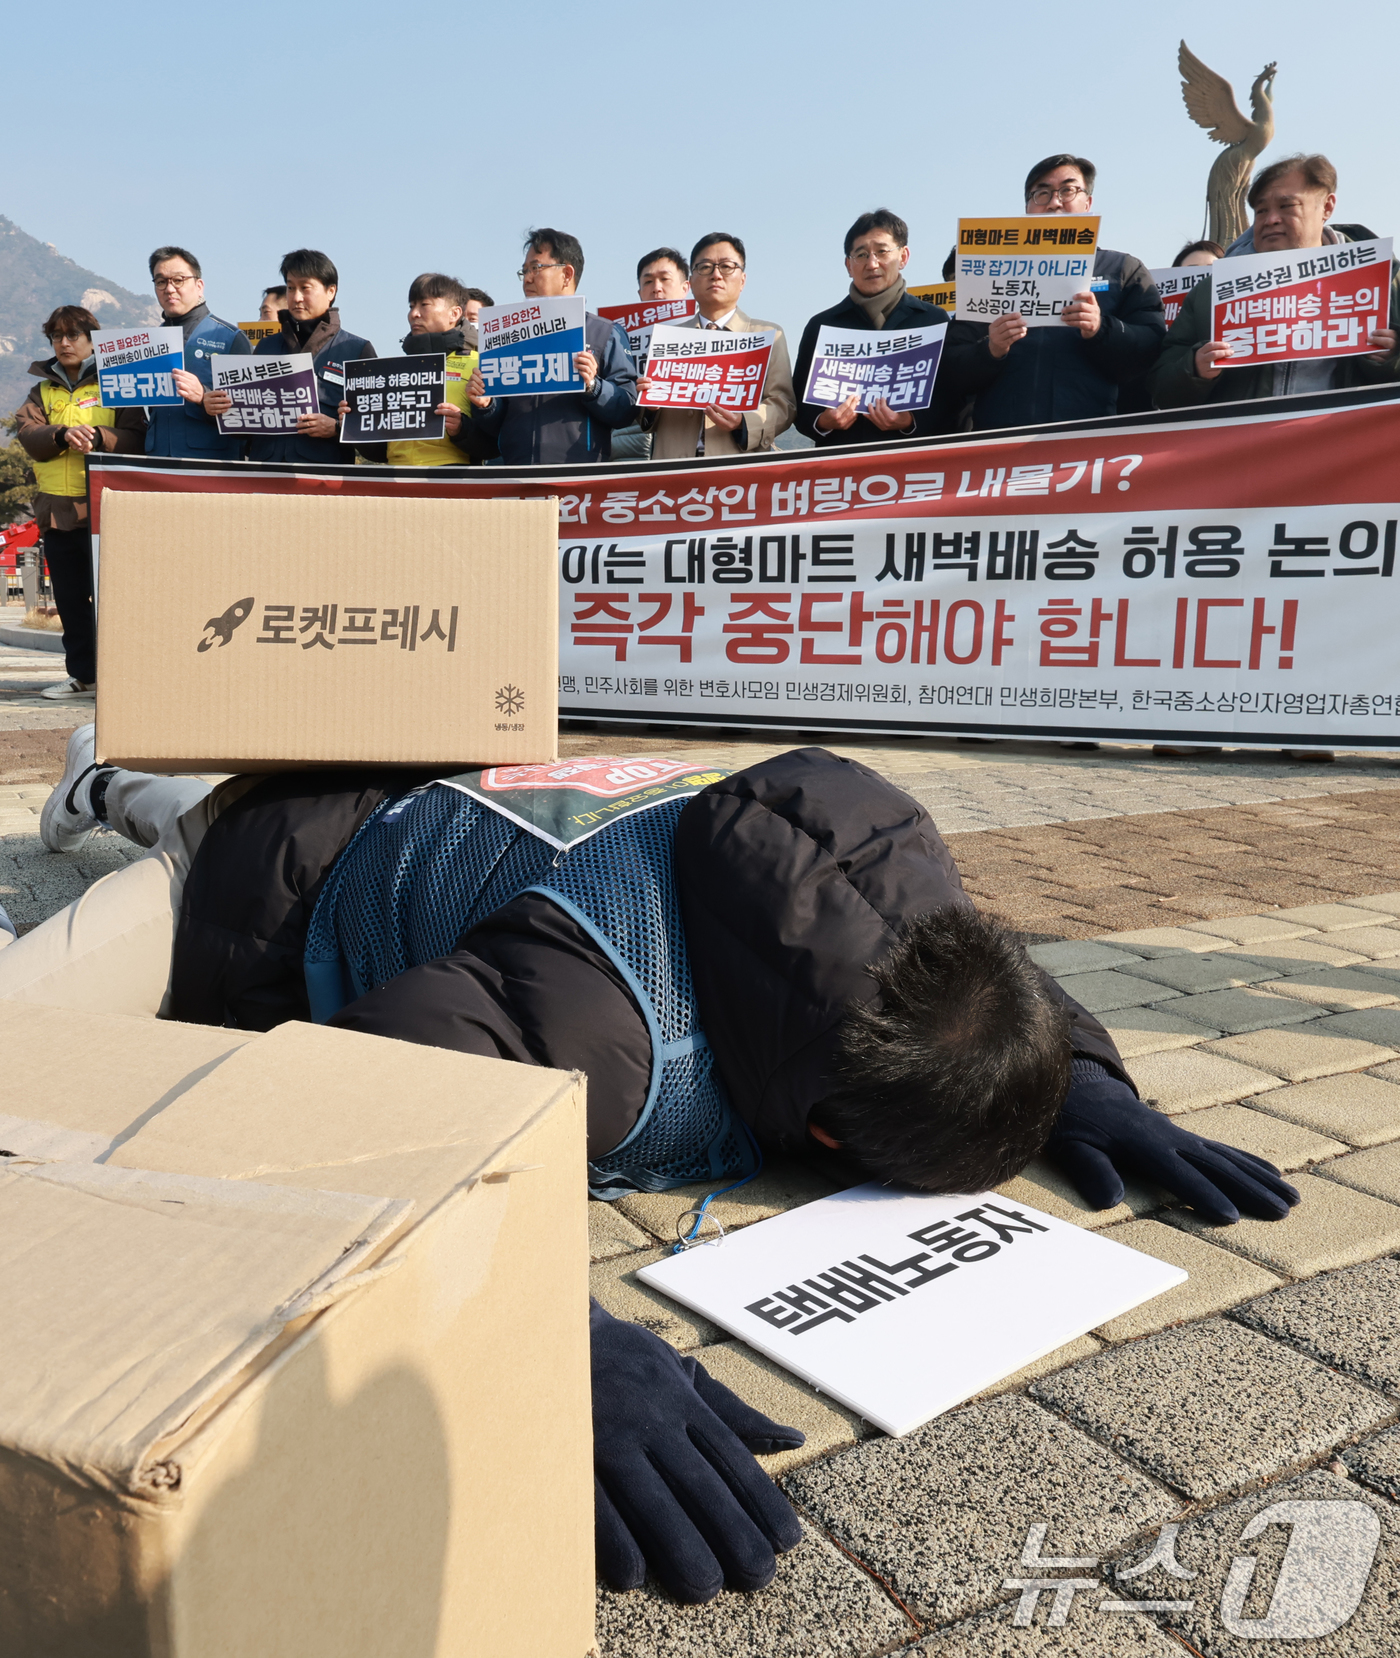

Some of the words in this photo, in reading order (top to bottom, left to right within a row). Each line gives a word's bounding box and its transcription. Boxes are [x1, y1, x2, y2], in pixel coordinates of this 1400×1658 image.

[960, 229, 1019, 246] 대형마트
[1023, 228, 1095, 245] 새벽배송
[961, 259, 986, 276] 쿠팡
[989, 260, 1034, 277] 잡기가
[1038, 259, 1088, 277] 아니라
[1216, 266, 1293, 301] 골목상권
[1298, 246, 1377, 279] 파괴하는
[991, 280, 1040, 299] 노동자,
[642, 300, 687, 324] 유발법
[966, 300, 1014, 316] 소상공인
[1222, 293, 1322, 325] 새벽배송
[1328, 286, 1380, 315] 논의
[483, 319, 499, 335] 지금
[502, 305, 541, 328] 필요한건
[98, 340, 115, 354] 지금
[117, 333, 150, 349] 필요한건
[484, 326, 530, 350] 새벽배송이
[533, 317, 567, 336] 아니라
[824, 343, 872, 357] 과로사
[876, 335, 923, 355] 부르는
[1222, 316, 1377, 358] 중단하라!
[102, 350, 142, 368] 새벽배송이
[145, 343, 169, 358] 아니라
[652, 342, 706, 357] 골목상권
[711, 336, 765, 353] 파괴하는
[217, 369, 252, 386] 과로사
[255, 361, 293, 379] 부르는
[346, 375, 386, 392] 새벽배송
[388, 371, 444, 387] 허용이라니
[652, 360, 723, 381] 새벽배송
[726, 364, 763, 382] 논의
[818, 359, 892, 383] 새벽배송
[896, 358, 933, 381] 논의
[280, 387, 312, 405] 논의
[356, 393, 383, 412] 명절
[386, 390, 431, 410] 앞두고
[645, 380, 757, 406] 중단하라!
[812, 377, 927, 407] 중단하라!
[360, 414, 374, 431] 더
[377, 411, 426, 431] 서럽다!
[600, 483, 759, 523] 중소상인
[770, 472, 945, 517] 벼랑으로
[955, 454, 1143, 498] 내몰기?
[664, 534, 857, 584] 대형마트
[875, 529, 1100, 582] 새벽배송
[1122, 525, 1245, 579] 허용
[1268, 519, 1398, 578] 논의
[255, 603, 460, 653] 로켓프레시
[570, 591, 705, 663] 즉각
[722, 591, 1016, 666] 중단해야
[1037, 597, 1299, 670] 합니다!
[584, 675, 658, 696] 민주사회를
[663, 678, 694, 697] 위한
[699, 679, 780, 700] 변호사모임
[785, 681, 912, 706] 민생경제위원회,
[918, 684, 993, 706] 참여연대
[1000, 686, 1124, 712] 민생희망본부,
[494, 722, 525, 732] 냉동/냉장
[567, 787, 667, 826] 중요합니다.
[743, 1203, 1050, 1336] 택배노동자
